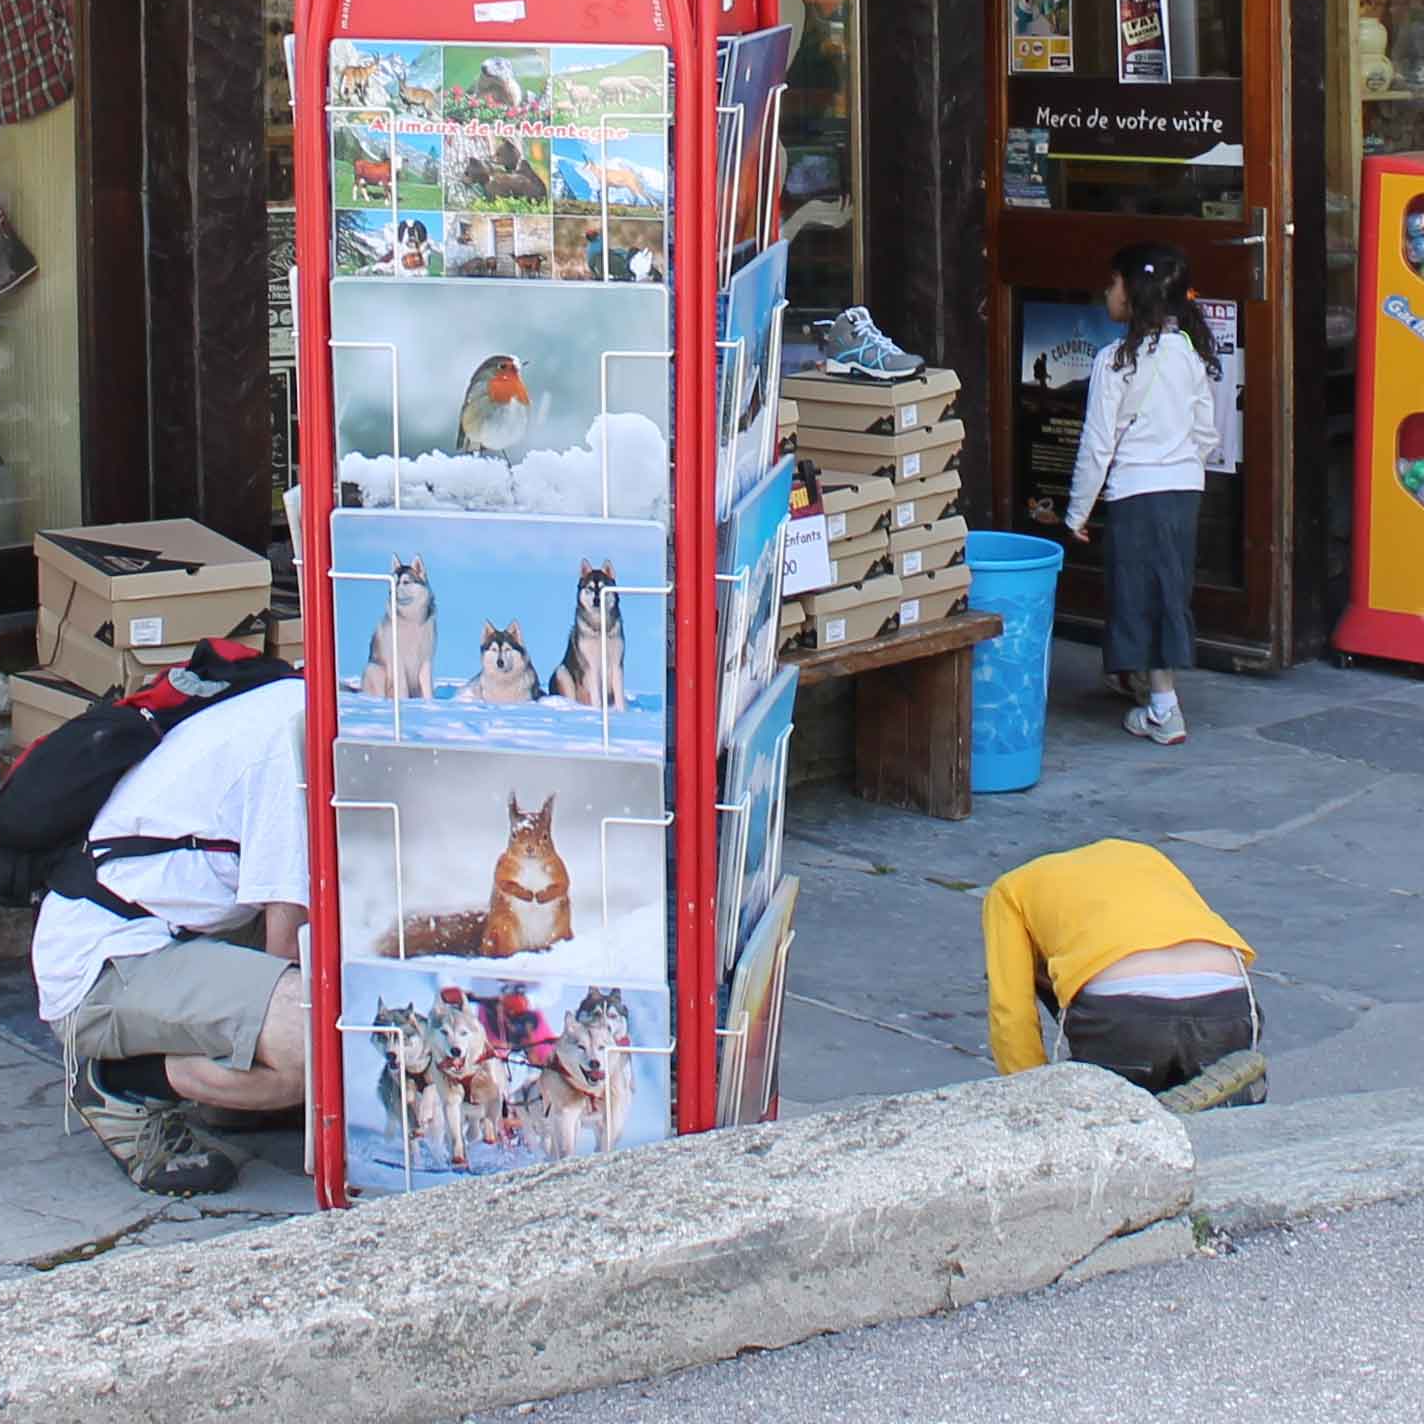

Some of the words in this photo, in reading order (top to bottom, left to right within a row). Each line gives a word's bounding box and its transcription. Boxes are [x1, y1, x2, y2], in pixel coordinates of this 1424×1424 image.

[464, 119, 488, 138] de
[494, 120, 516, 138] la
[1036, 106, 1081, 128] Merci
[1086, 107, 1108, 129] de
[1116, 109, 1167, 131] votre
[1172, 110, 1224, 134] visite
